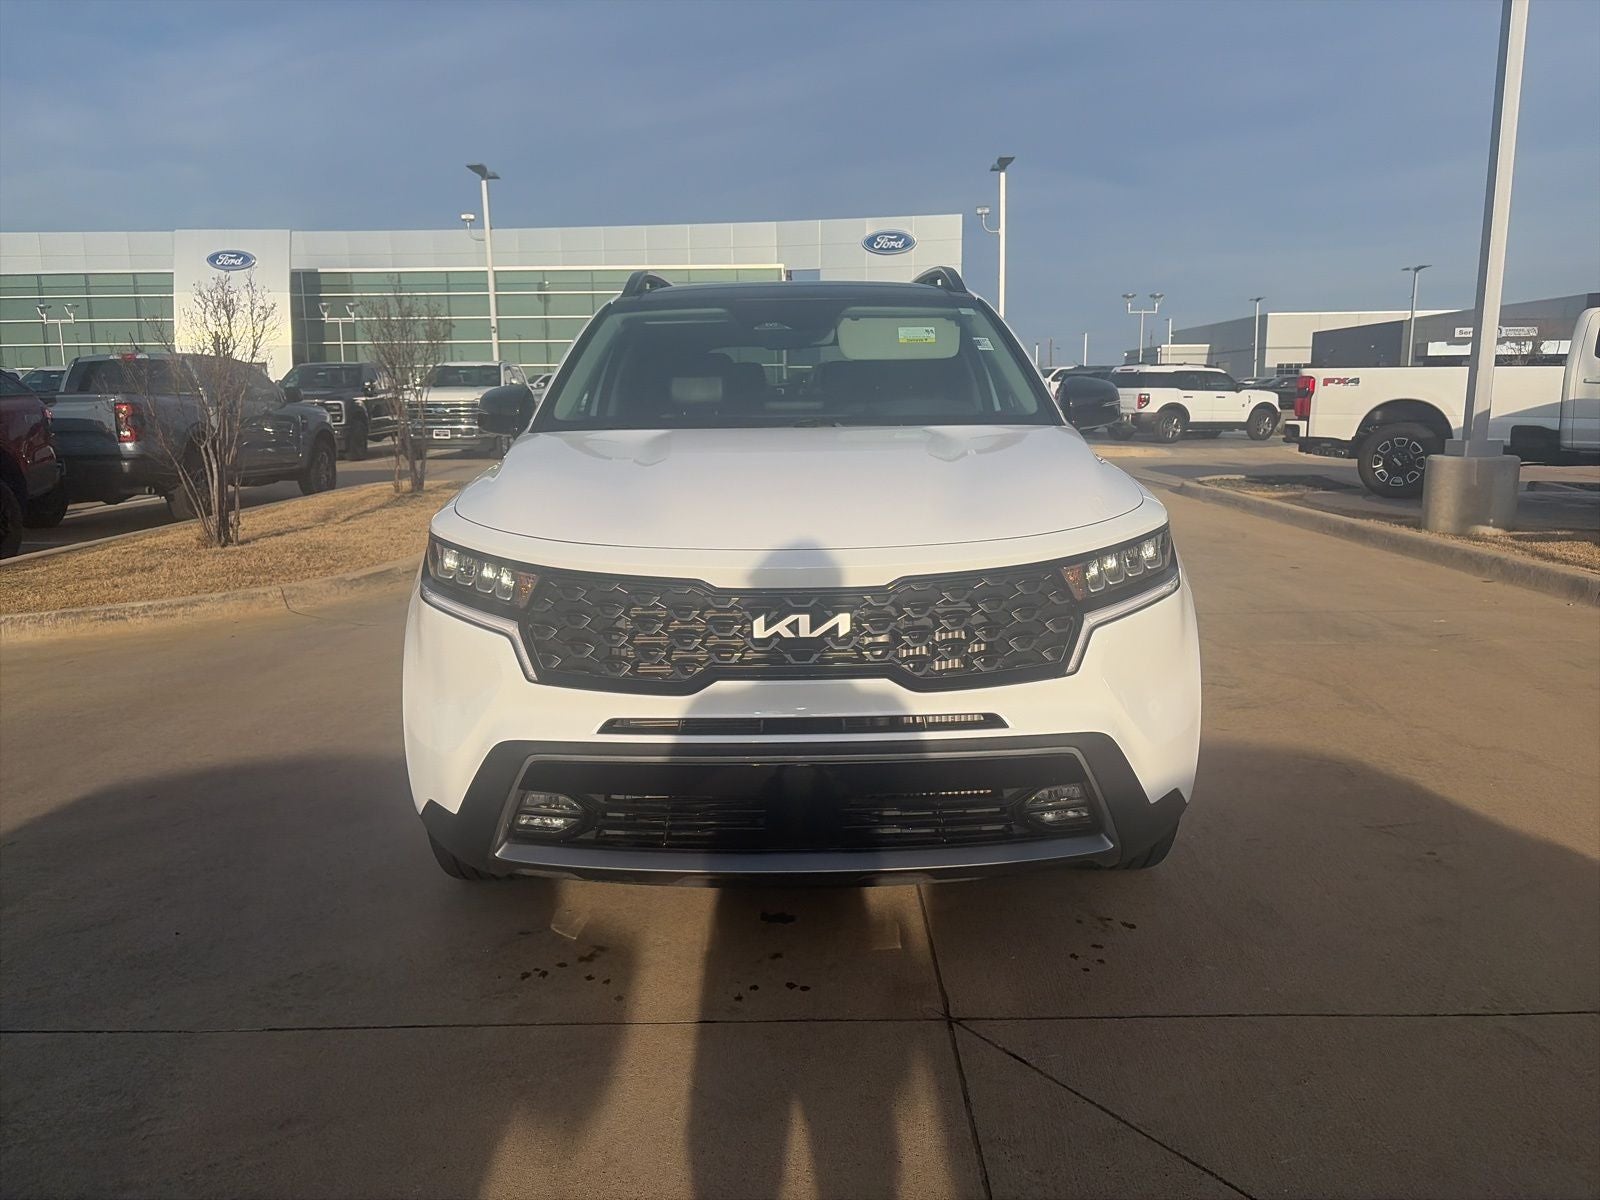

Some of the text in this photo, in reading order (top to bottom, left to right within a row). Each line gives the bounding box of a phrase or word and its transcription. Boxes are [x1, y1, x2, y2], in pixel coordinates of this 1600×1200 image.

[873, 235, 905, 249] Ford
[215, 253, 244, 265] Ford
[1322, 377, 1360, 387] FX4
[753, 612, 851, 639] KIA
